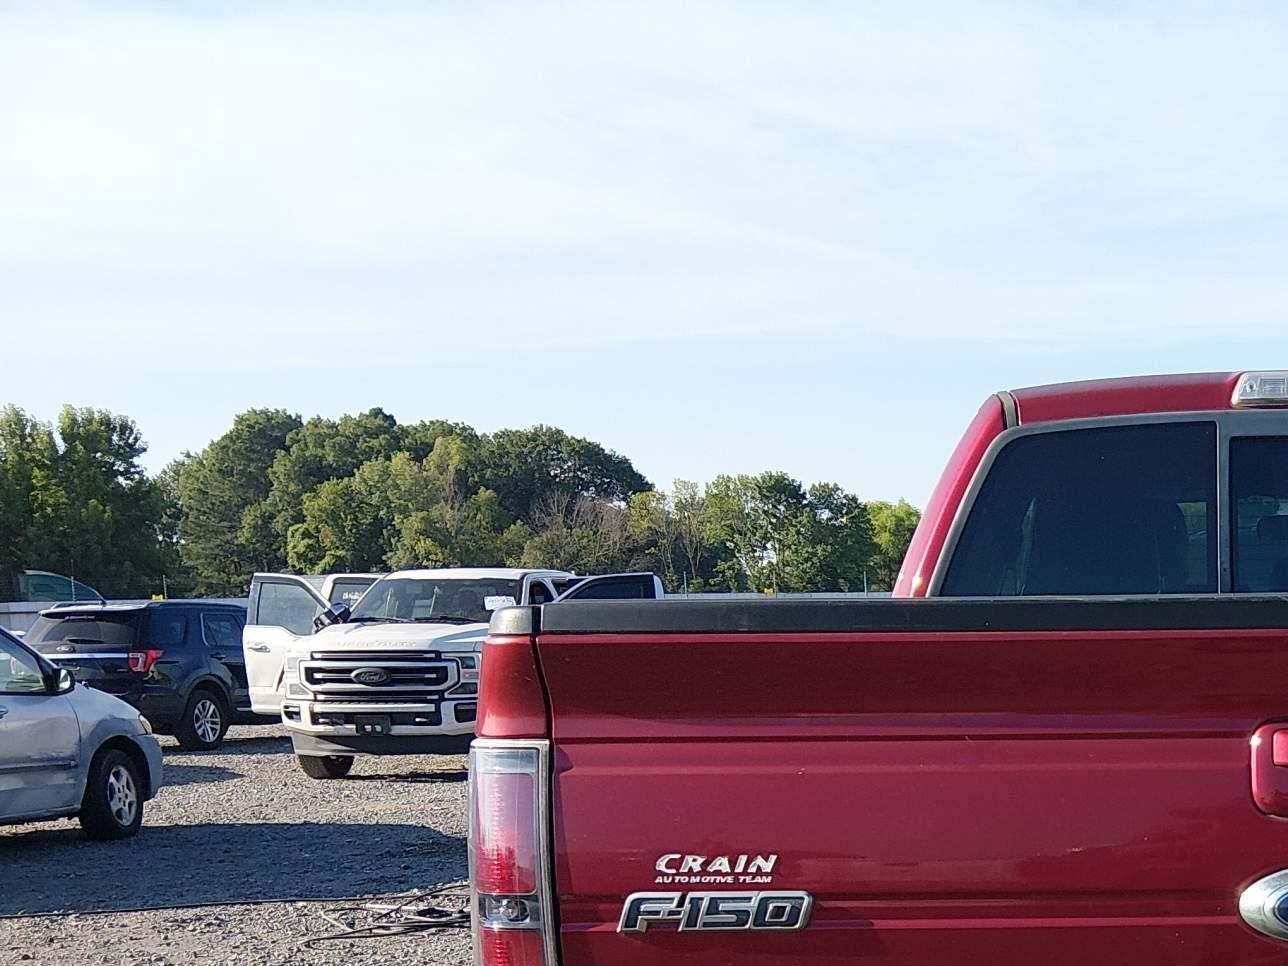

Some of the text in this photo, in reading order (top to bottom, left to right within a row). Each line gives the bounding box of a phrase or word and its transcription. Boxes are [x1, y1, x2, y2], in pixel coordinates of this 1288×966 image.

[655, 853, 778, 874] CRAIN
[654, 875, 772, 884] AUTOMOTIVE TEAM
[616, 890, 814, 933] F-150
